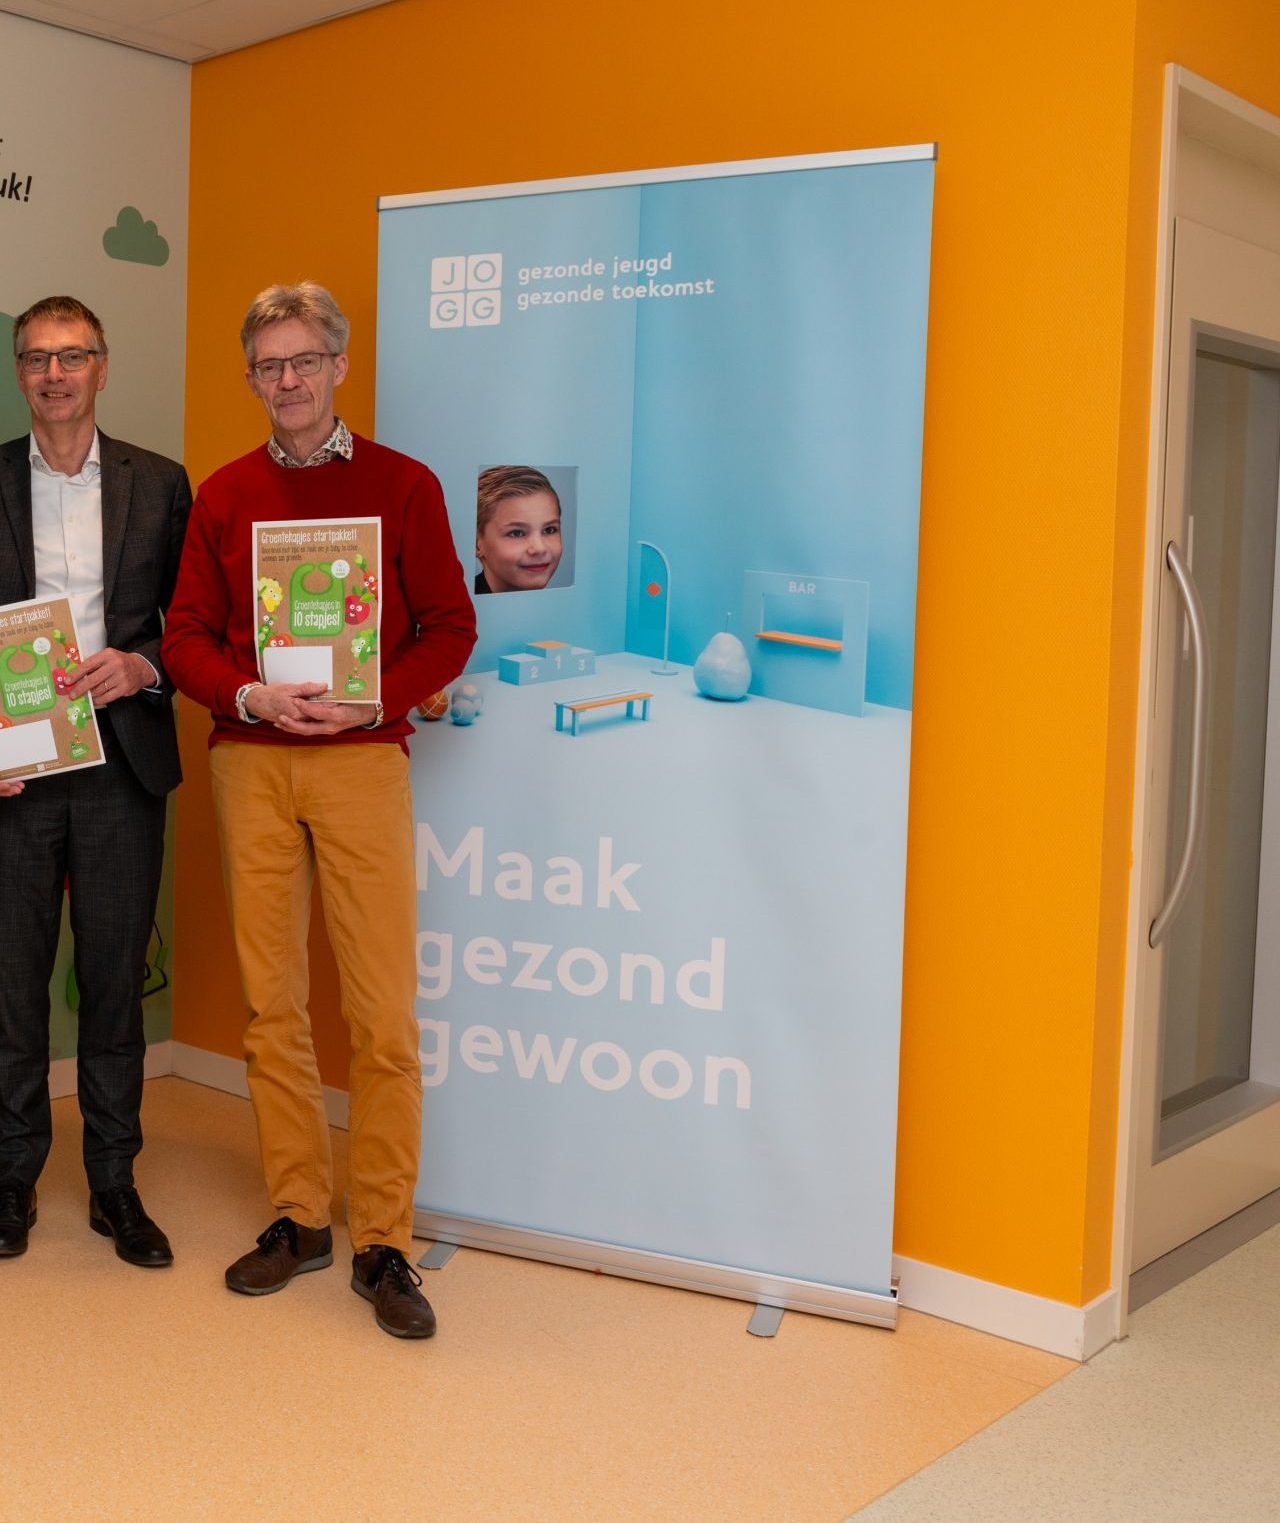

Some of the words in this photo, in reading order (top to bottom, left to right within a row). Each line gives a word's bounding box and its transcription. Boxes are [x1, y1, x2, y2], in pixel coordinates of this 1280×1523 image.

[518, 259, 605, 285] gezonde
[612, 252, 672, 278] jeugd
[517, 285, 604, 310] gezonde
[612, 278, 715, 300] toekomst
[261, 531, 311, 545] Groentehapjes
[788, 581, 817, 596] BAR
[530, 665, 539, 679] 2
[554, 655, 561, 670] 1
[578, 659, 586, 671] 3
[415, 821, 642, 912] Maak
[415, 930, 726, 1012] gezond
[416, 1015, 752, 1110] gewoon
